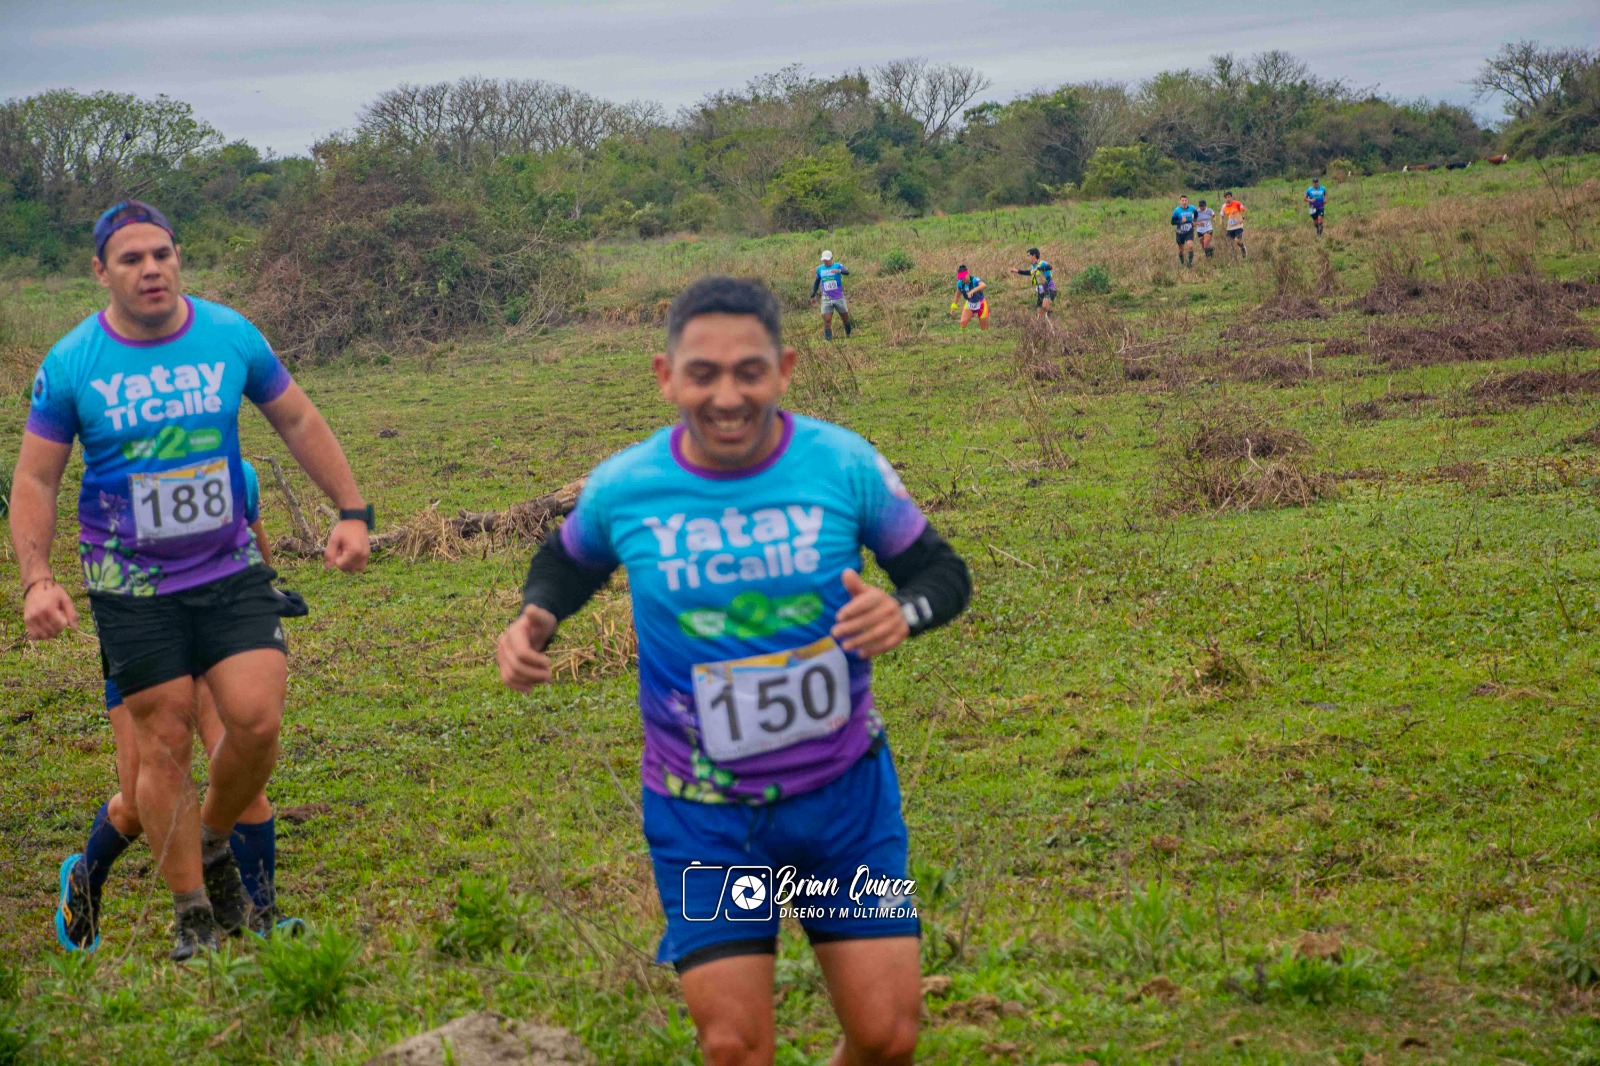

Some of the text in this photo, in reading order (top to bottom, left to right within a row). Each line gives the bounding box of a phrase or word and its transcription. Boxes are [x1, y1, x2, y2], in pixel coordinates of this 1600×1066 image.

[90, 361, 226, 407] Yatay
[104, 390, 223, 431] Tí Calle
[157, 425, 187, 460] 2
[141, 478, 227, 528] 188
[642, 505, 824, 557] Yatay
[658, 541, 821, 592] Tí Calle
[709, 664, 836, 741] 150
